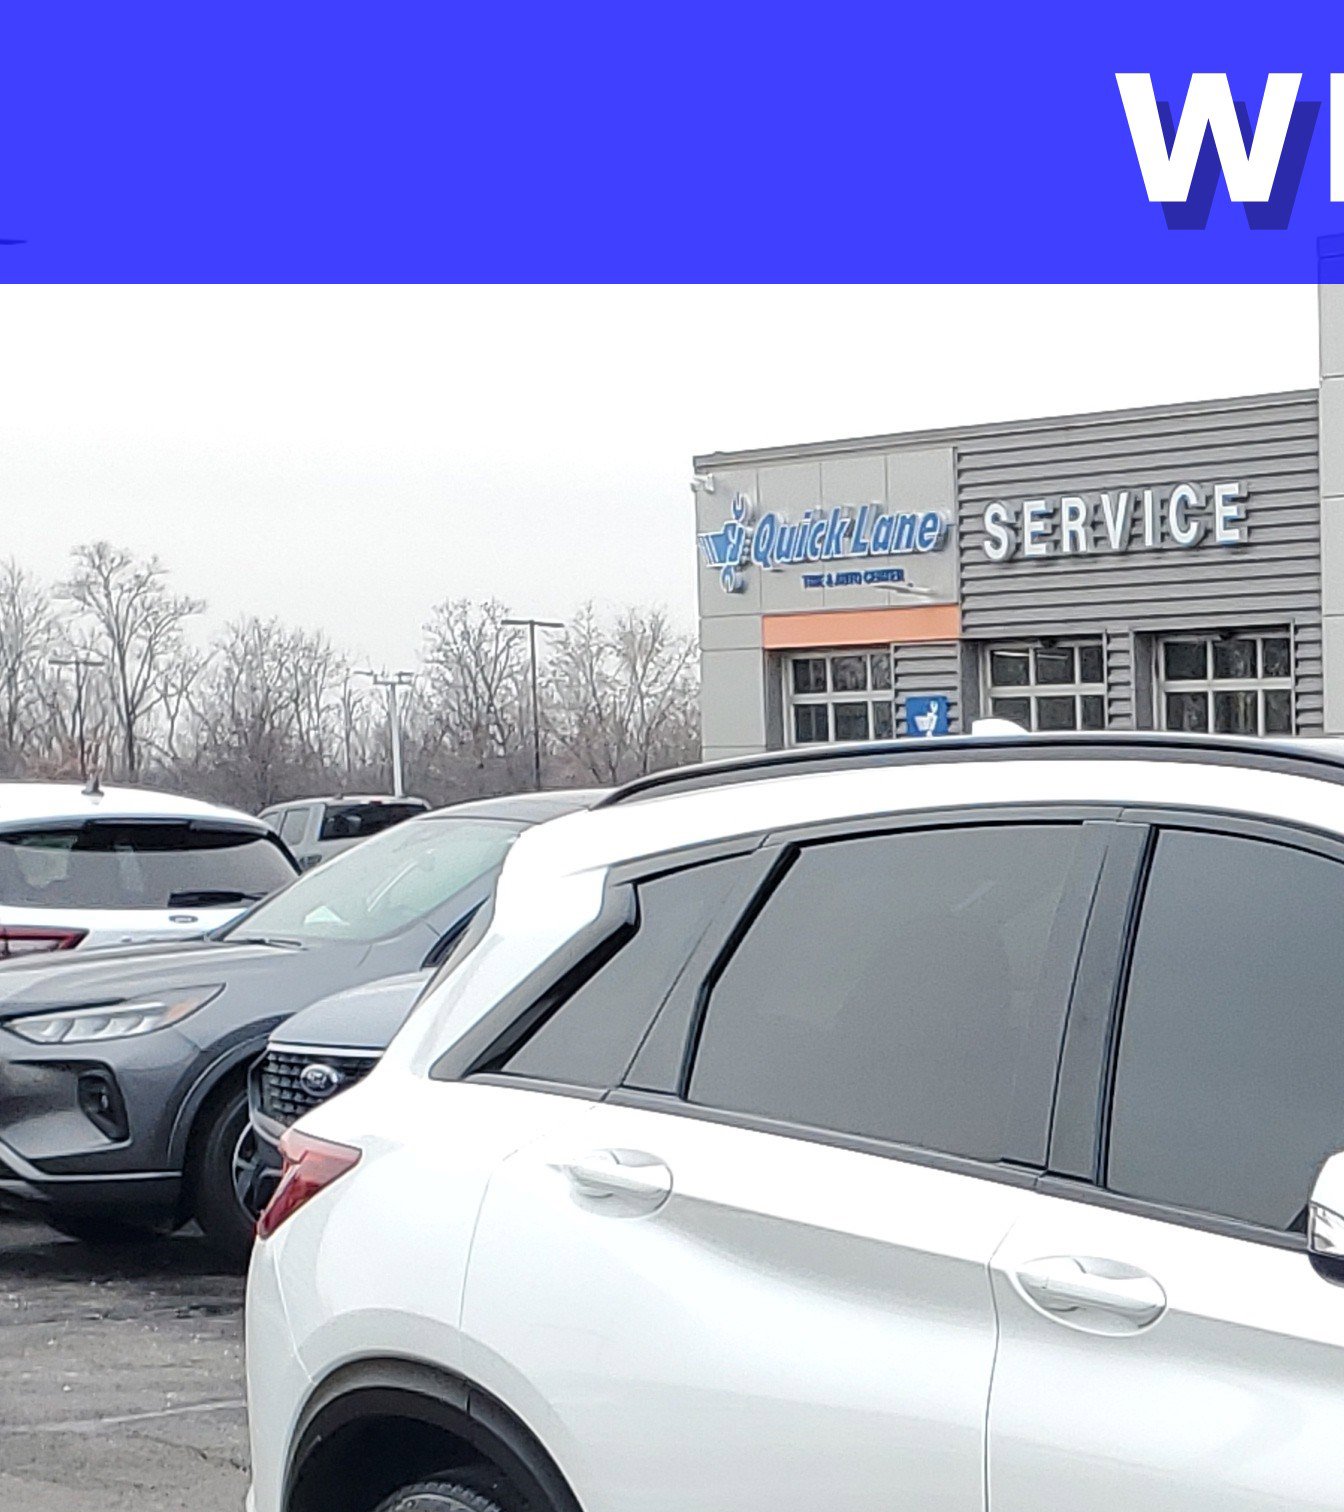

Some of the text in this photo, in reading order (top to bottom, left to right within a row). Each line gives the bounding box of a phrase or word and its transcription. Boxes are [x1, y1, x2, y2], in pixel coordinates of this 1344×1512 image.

[752, 504, 939, 568] Quick Lane
[983, 482, 1241, 562] SERVICE
